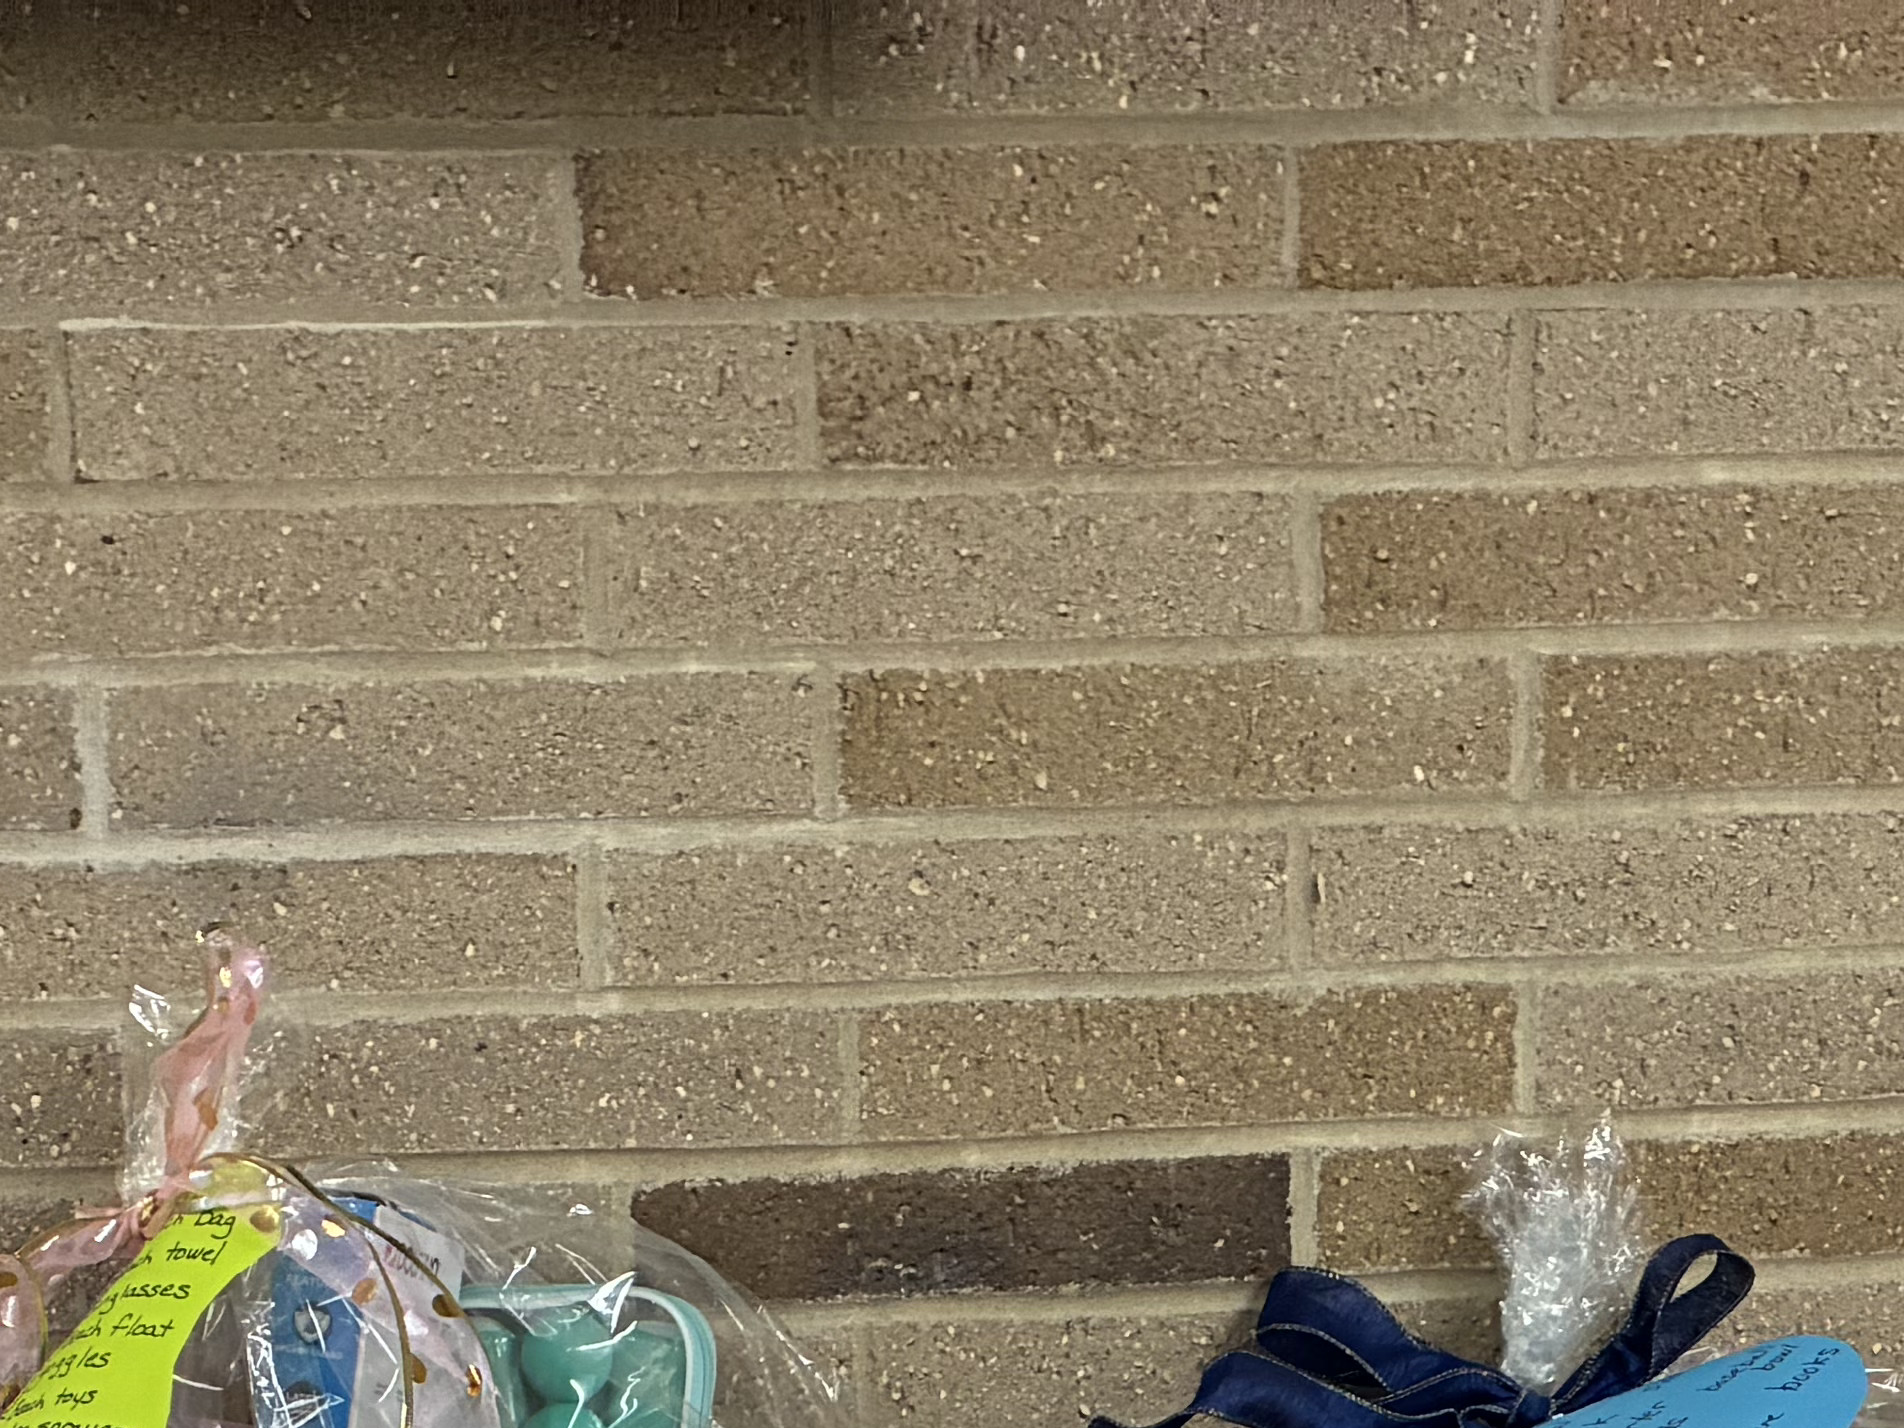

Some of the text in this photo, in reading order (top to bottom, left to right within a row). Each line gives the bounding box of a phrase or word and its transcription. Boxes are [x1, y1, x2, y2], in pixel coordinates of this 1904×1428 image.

[165, 1219, 228, 1266] towel
[109, 1312, 175, 1338] float
[54, 1387, 99, 1411] toys
